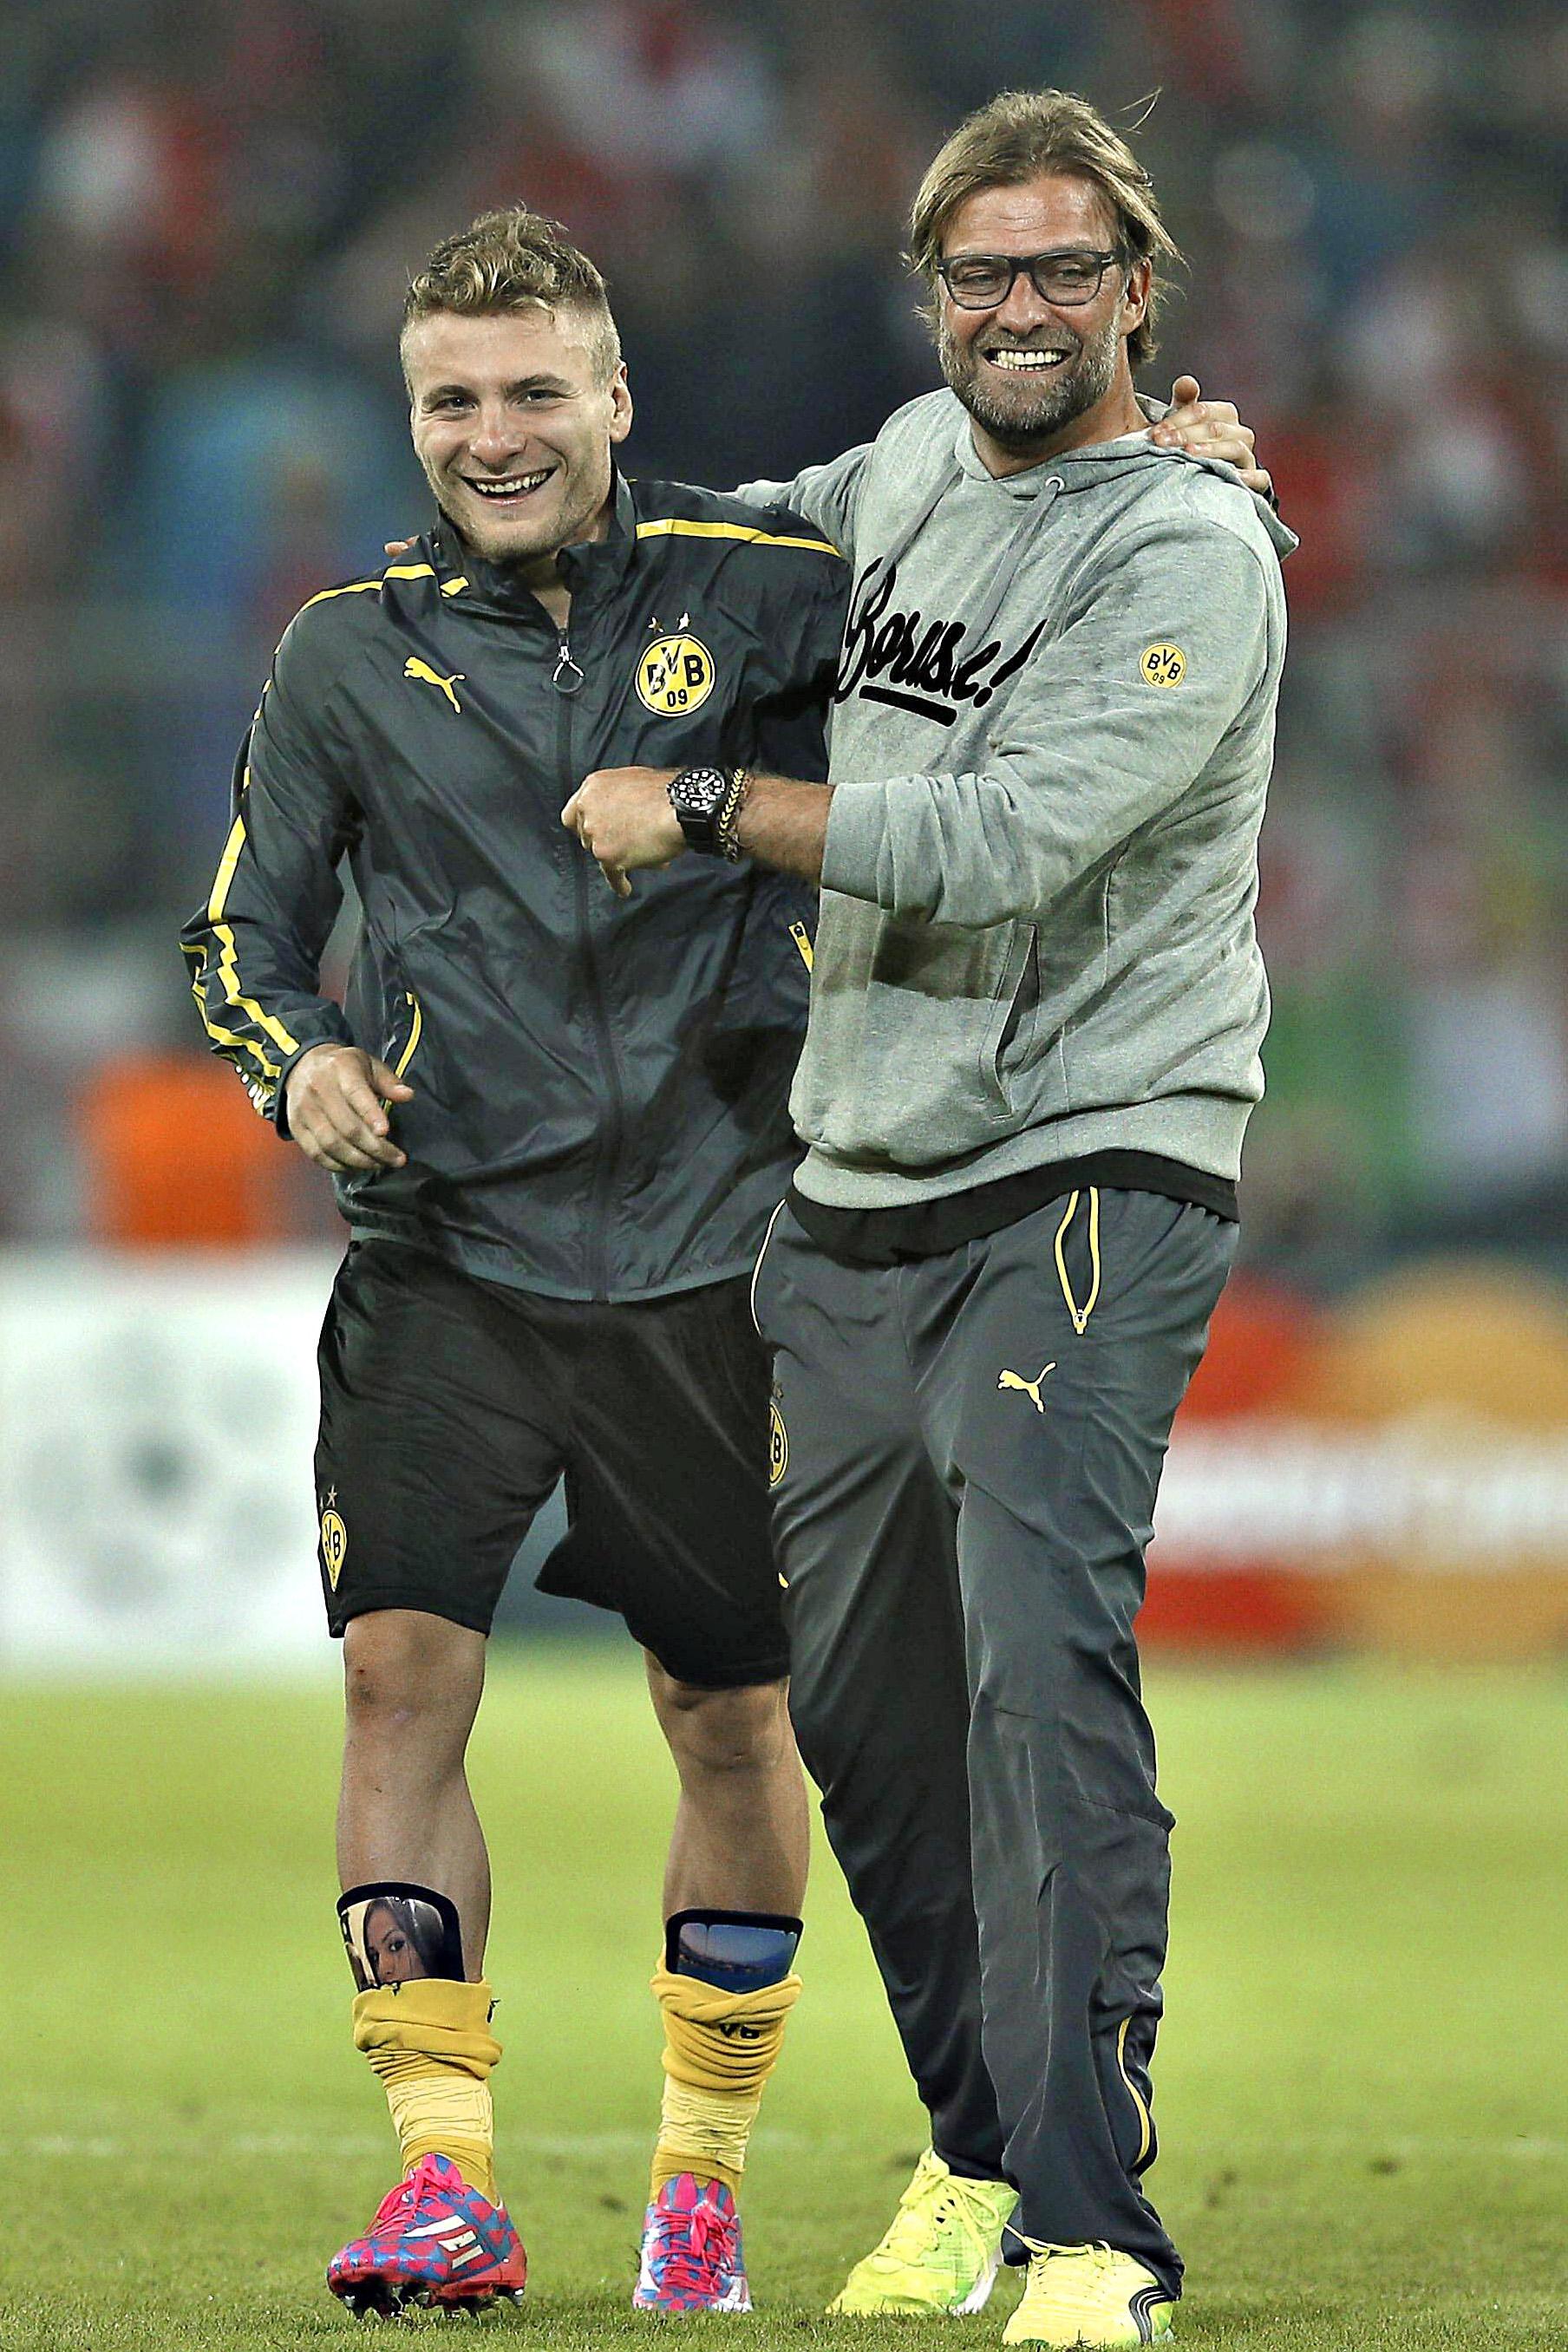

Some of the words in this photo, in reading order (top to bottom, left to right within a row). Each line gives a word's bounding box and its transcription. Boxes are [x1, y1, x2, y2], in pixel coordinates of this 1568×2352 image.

[646, 643, 705, 696] BVB
[1147, 649, 1181, 680] BVB
[1153, 672, 1166, 684] 09
[666, 689, 688, 708] 09
